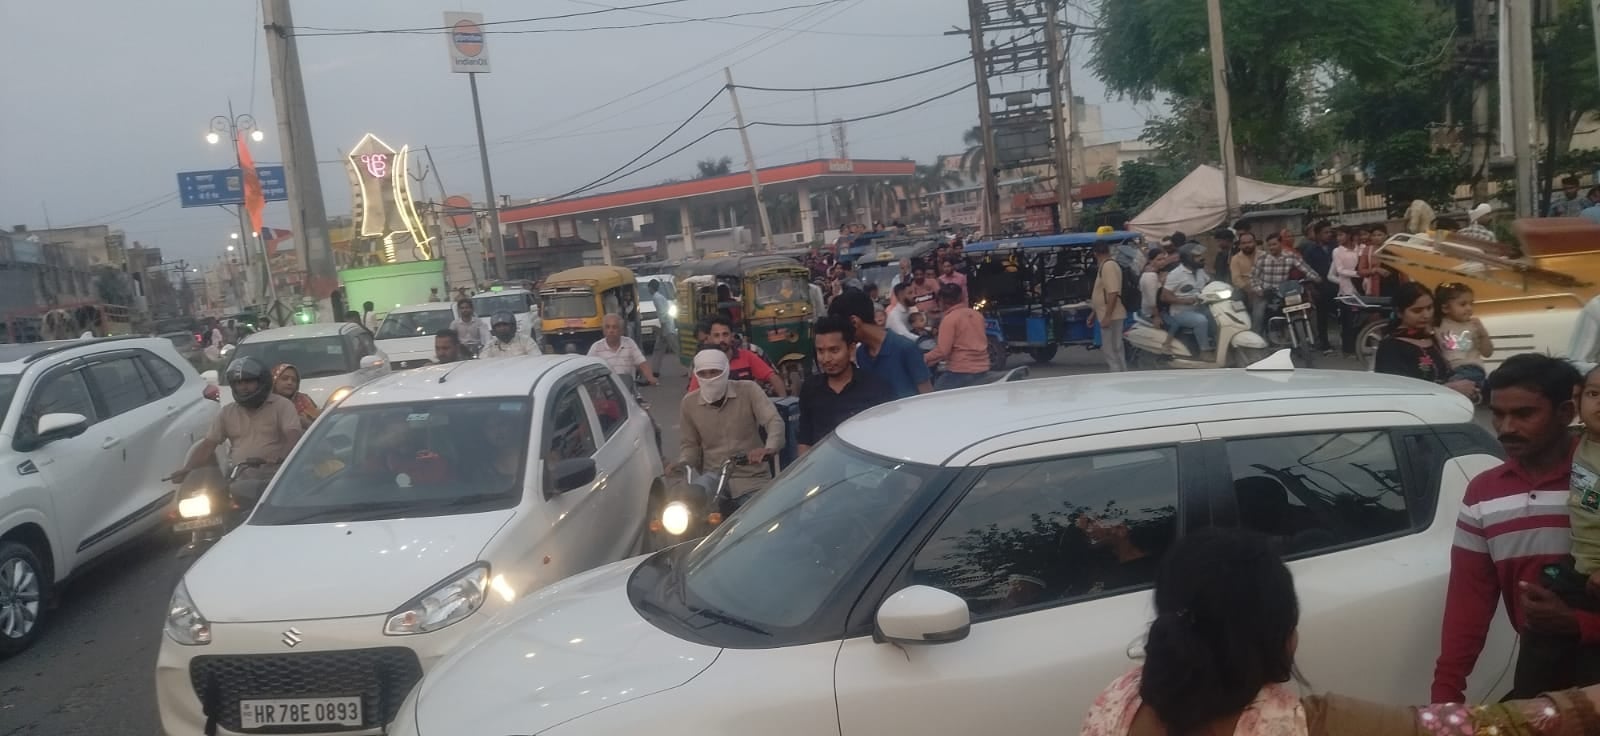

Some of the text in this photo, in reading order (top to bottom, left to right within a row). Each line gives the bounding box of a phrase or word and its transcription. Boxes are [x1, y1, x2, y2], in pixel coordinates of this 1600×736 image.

[255, 705, 275, 723] HR
[279, 704, 310, 722] 78E
[315, 703, 357, 721] 0893
